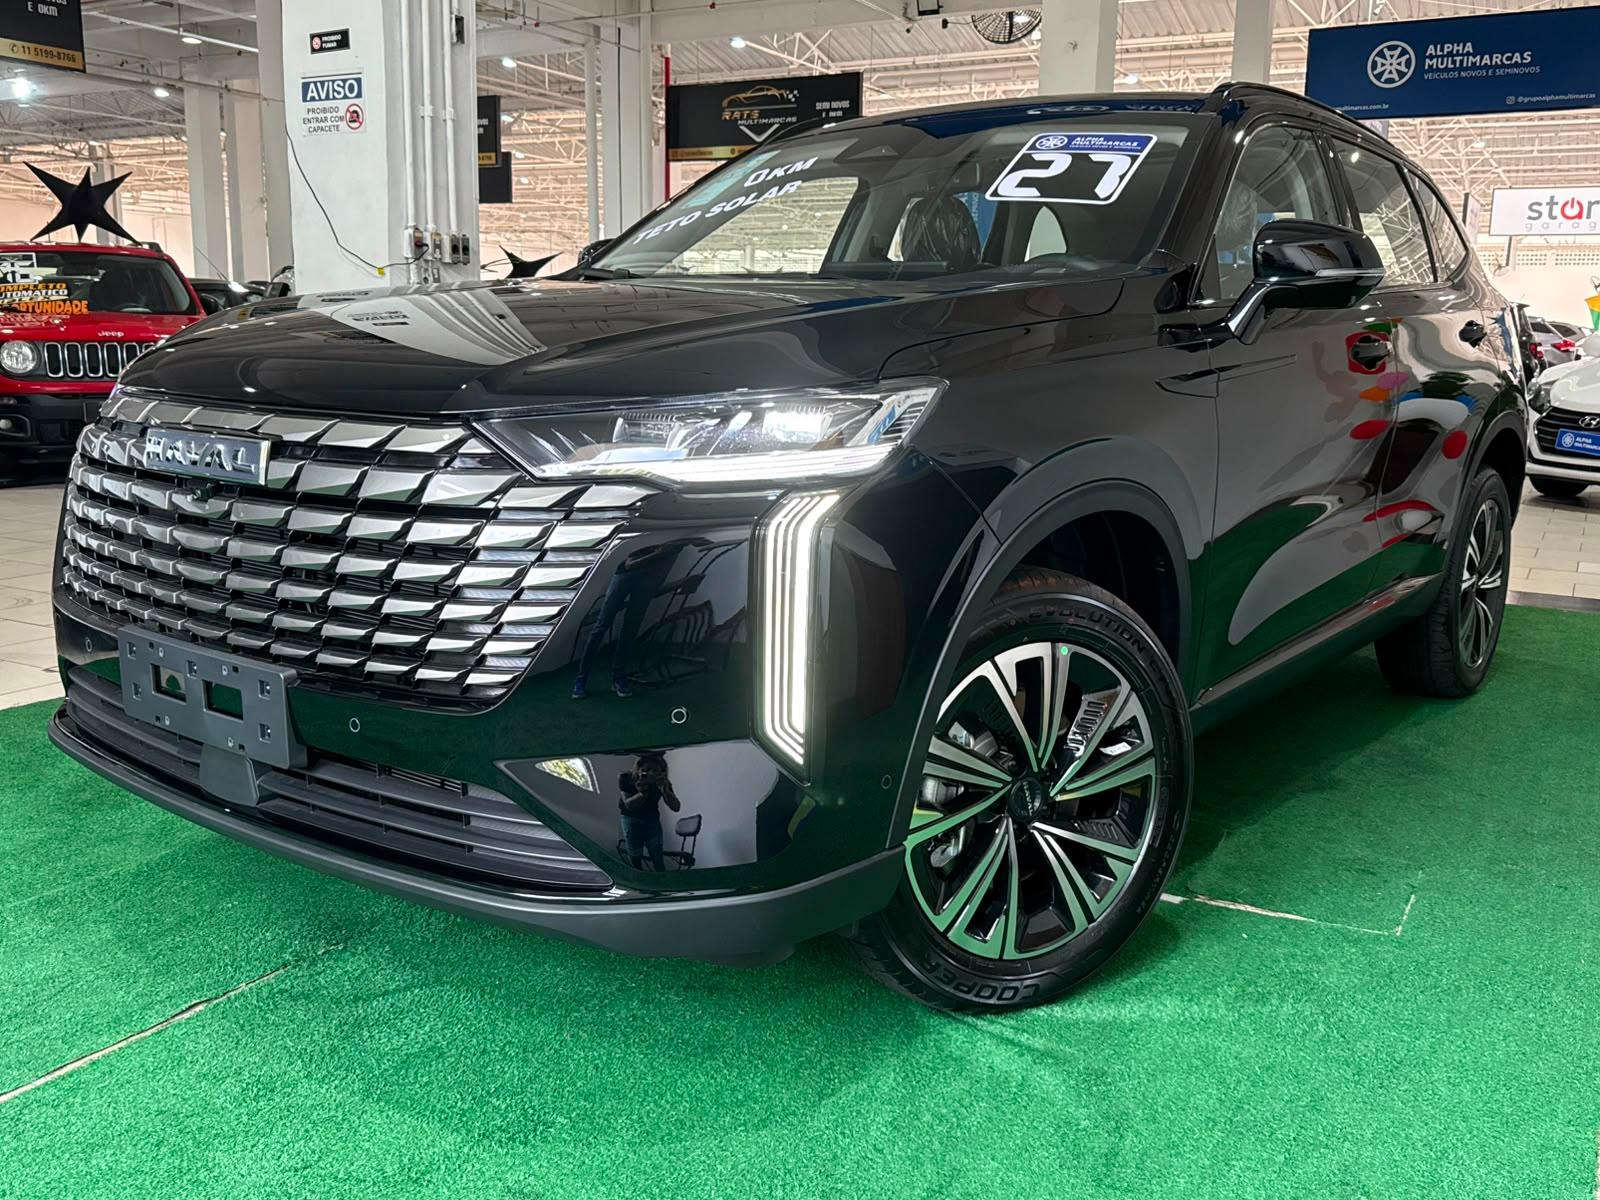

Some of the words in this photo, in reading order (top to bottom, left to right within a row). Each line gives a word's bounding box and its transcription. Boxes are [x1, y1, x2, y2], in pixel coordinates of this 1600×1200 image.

[21, 45, 31, 55] 11
[1425, 42, 1473, 57] ALPHA
[1424, 51, 1532, 70] MULTIMARCAS
[1460, 69, 1487, 78] NOVOS
[1488, 68, 1494, 76] E
[1495, 65, 1540, 76] SEMINOVOS
[306, 79, 358, 101] AVISO
[306, 106, 340, 115] PROIBIDO
[721, 110, 761, 121] RATS
[302, 116, 329, 125] ENTRAR
[329, 115, 345, 123] COM
[737, 116, 798, 126] MULTIMARCAS
[308, 125, 340, 133] CAPACETE
[632, 211, 702, 245] TETO
[705, 180, 802, 218] SOLAR
[0, 282, 67, 293] OMPLETO
[0, 288, 68, 299] UTOMATICO
[98, 330, 125, 338] Jeep
[1028, 606, 1149, 654] EVOLUTION
[917, 953, 1041, 1002] COOPER
